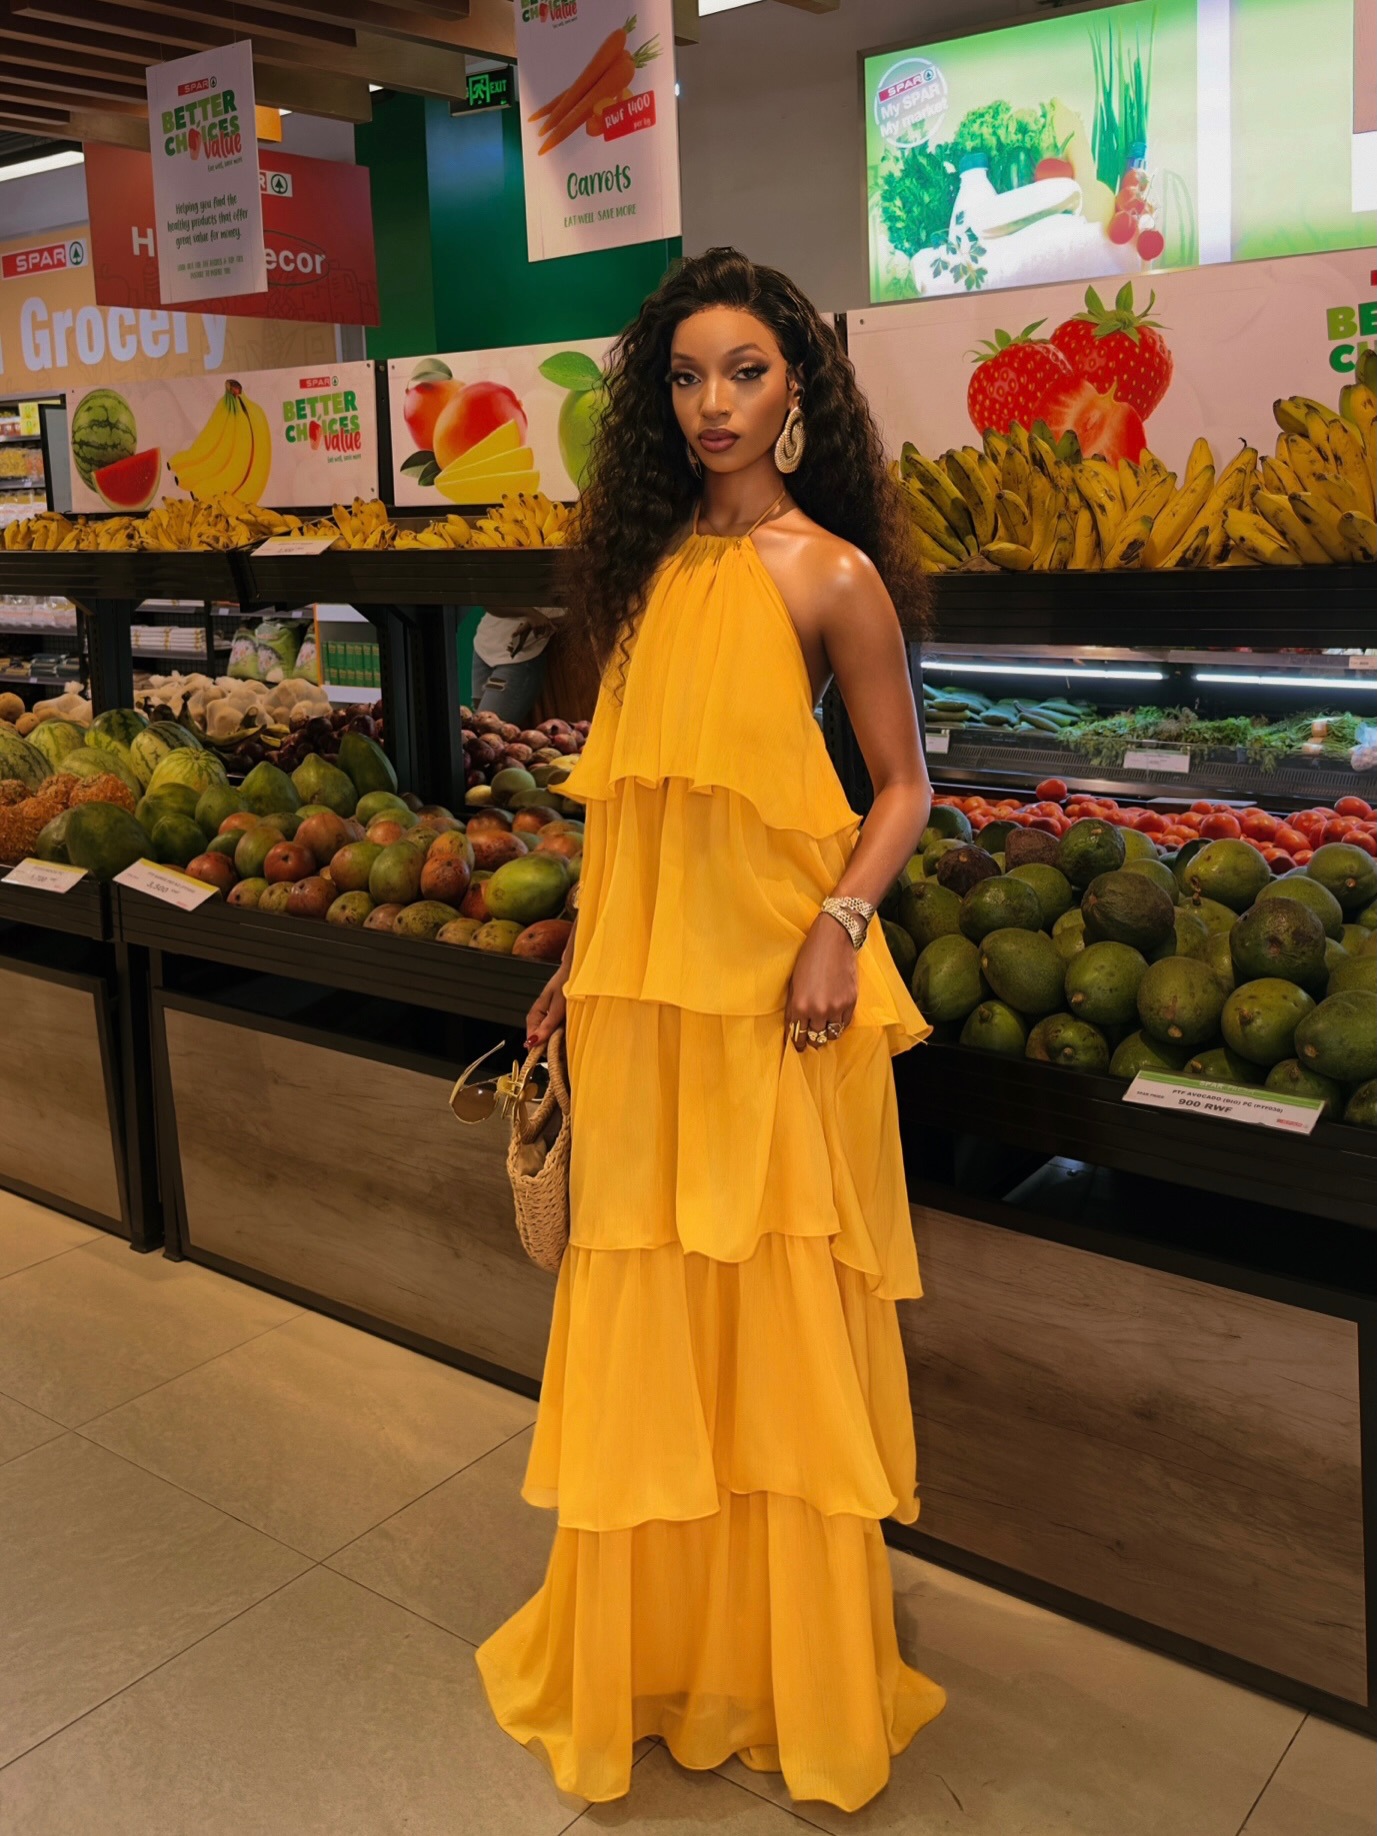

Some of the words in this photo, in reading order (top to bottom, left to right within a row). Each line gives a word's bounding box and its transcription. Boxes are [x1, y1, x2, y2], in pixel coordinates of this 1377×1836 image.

[184, 80, 209, 93] SPAR
[490, 80, 507, 94] EXIT
[887, 74, 922, 97] SPAR
[161, 89, 237, 134] BETTER
[627, 93, 651, 116] 1400
[880, 101, 901, 119] My
[902, 83, 940, 109] SPAR
[880, 120, 899, 137] My
[566, 164, 632, 200] Carrots
[175, 201, 199, 215] Helping
[200, 200, 212, 213] you
[213, 194, 226, 208] find
[227, 193, 237, 206] the
[597, 207, 614, 221] SAVE
[616, 203, 637, 217] MORE
[167, 218, 190, 232] healthy
[191, 214, 217, 230] products
[218, 211, 232, 224] that
[233, 208, 248, 221] offer
[175, 235, 192, 249] great
[192, 232, 209, 243] value
[210, 229, 219, 242] for
[15, 246, 66, 272] SPAR
[264, 248, 326, 275] ecor
[20, 296, 227, 372] Grocery
[306, 378, 330, 388] SPAR
[282, 390, 358, 423] BETTER
[1199, 1080, 1224, 1089] SPAR
[1178, 1098, 1201, 1107] 900
[1204, 1102, 1233, 1113] RWF
[1187, 1092, 1222, 1101] AVOCADO
